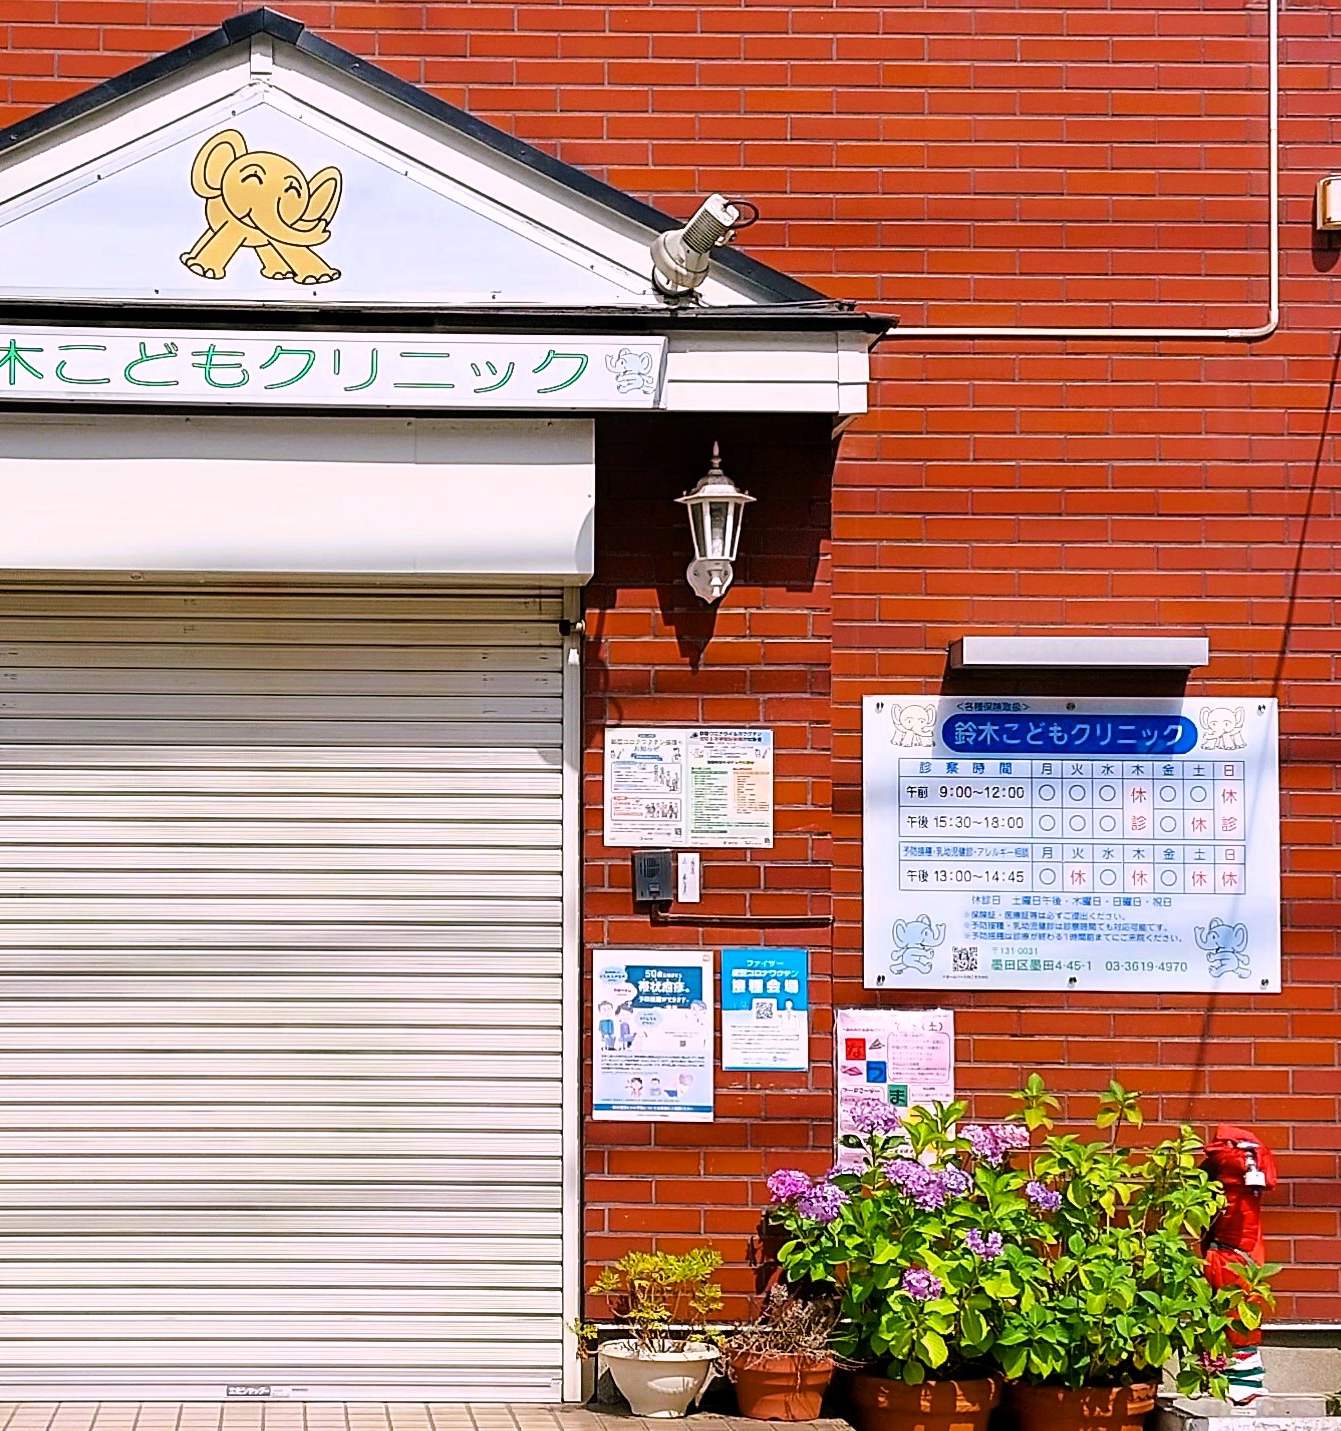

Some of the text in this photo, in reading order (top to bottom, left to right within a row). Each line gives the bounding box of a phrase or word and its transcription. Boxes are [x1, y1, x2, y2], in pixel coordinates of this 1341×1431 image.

[954, 721, 1184, 746] 鈴木こどもクリニック
[919, 761, 1235, 777] 診察時間 月 火 水 木 金 土 日
[906, 785, 929, 799] 午前
[906, 815, 929, 829] 午後
[1191, 816, 1207, 833] 休
[1041, 847, 1053, 859] 月
[1071, 847, 1085, 860] 火
[1102, 848, 1115, 860] 水
[1132, 847, 1146, 860] 木
[1163, 848, 1176, 861] 金
[1194, 848, 1206, 861] 土
[1224, 848, 1236, 861] 日
[906, 869, 929, 883] 午後
[1070, 869, 1086, 886] 休
[1132, 870, 1148, 887] 休
[1191, 871, 1207, 887] 休
[1221, 871, 1238, 888] 休
[971, 894, 1001, 906] 休診日
[746, 959, 784, 968] ファイザー
[1105, 961, 1188, 972] 03-3619-4970
[848, 1042, 864, 1058] な
[867, 1066, 884, 1080] つ
[888, 1088, 905, 1105] ま
